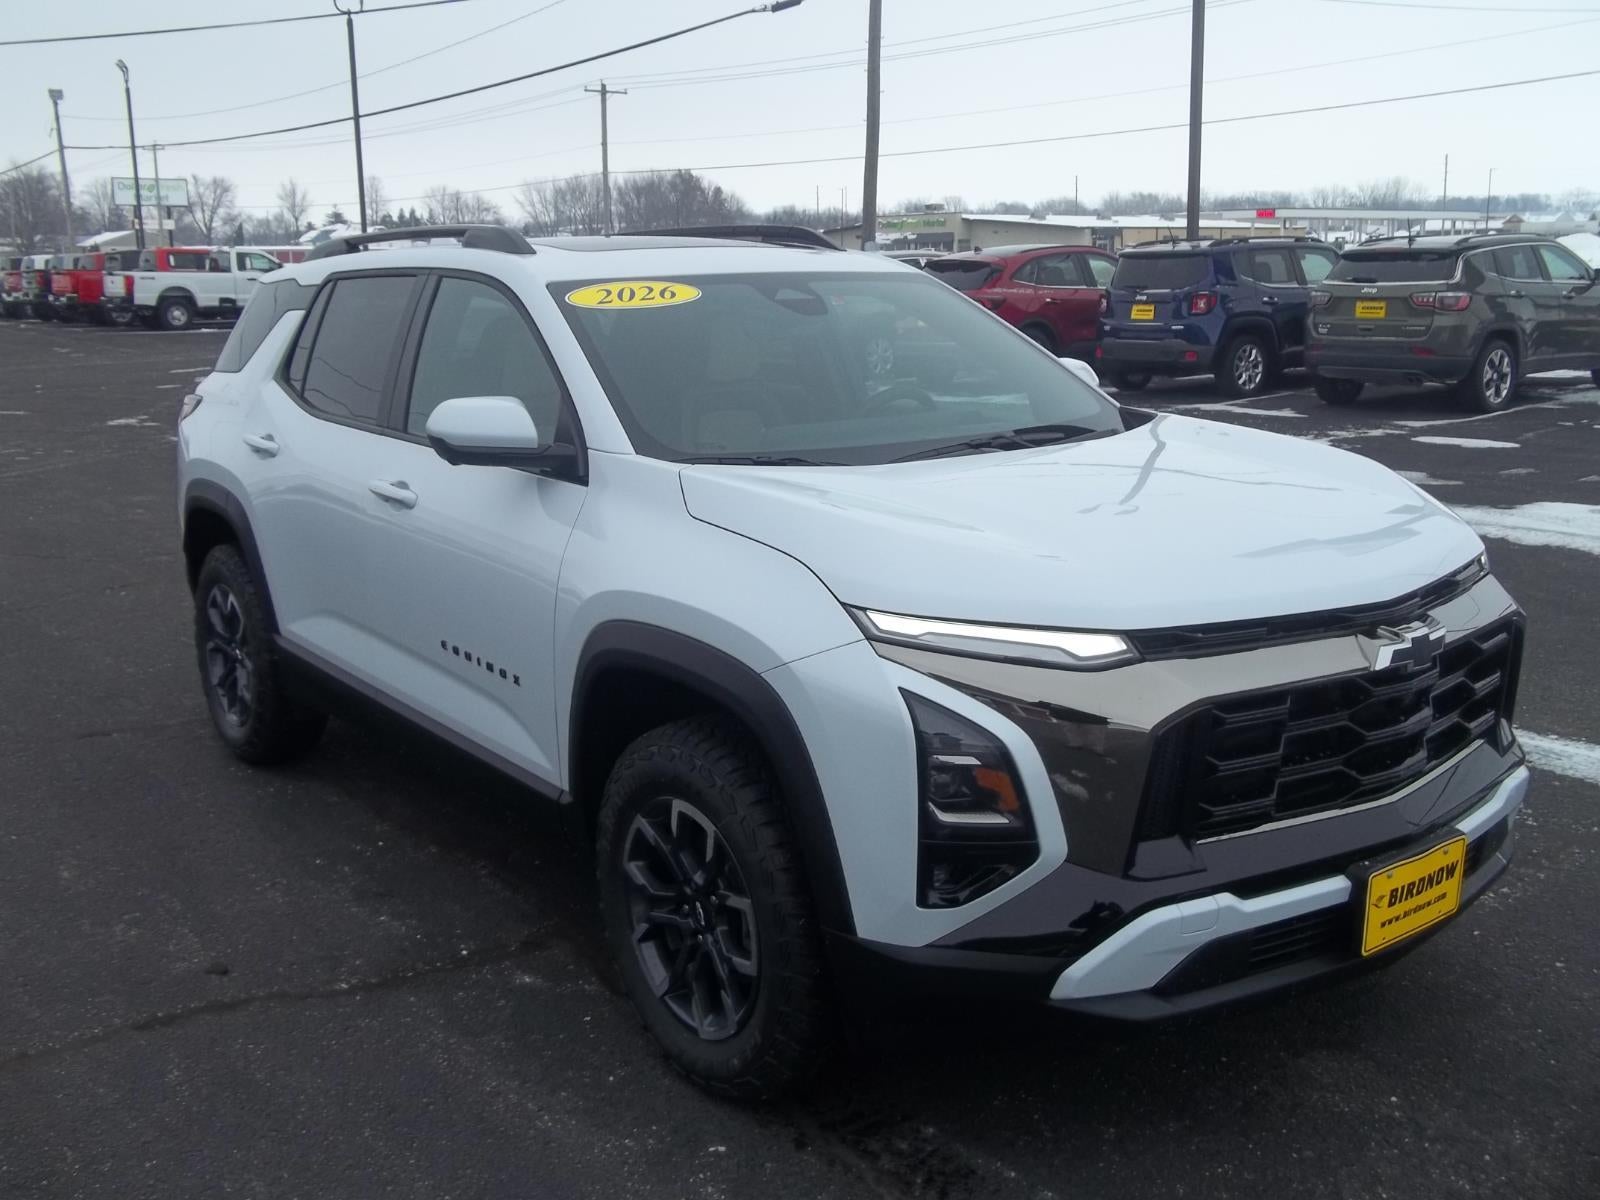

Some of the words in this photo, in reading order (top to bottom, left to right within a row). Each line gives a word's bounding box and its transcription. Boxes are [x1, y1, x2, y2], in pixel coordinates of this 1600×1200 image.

[596, 285, 677, 305] 2026
[440, 639, 521, 688] EQUINOX
[1387, 859, 1459, 909] BIRDNOW
